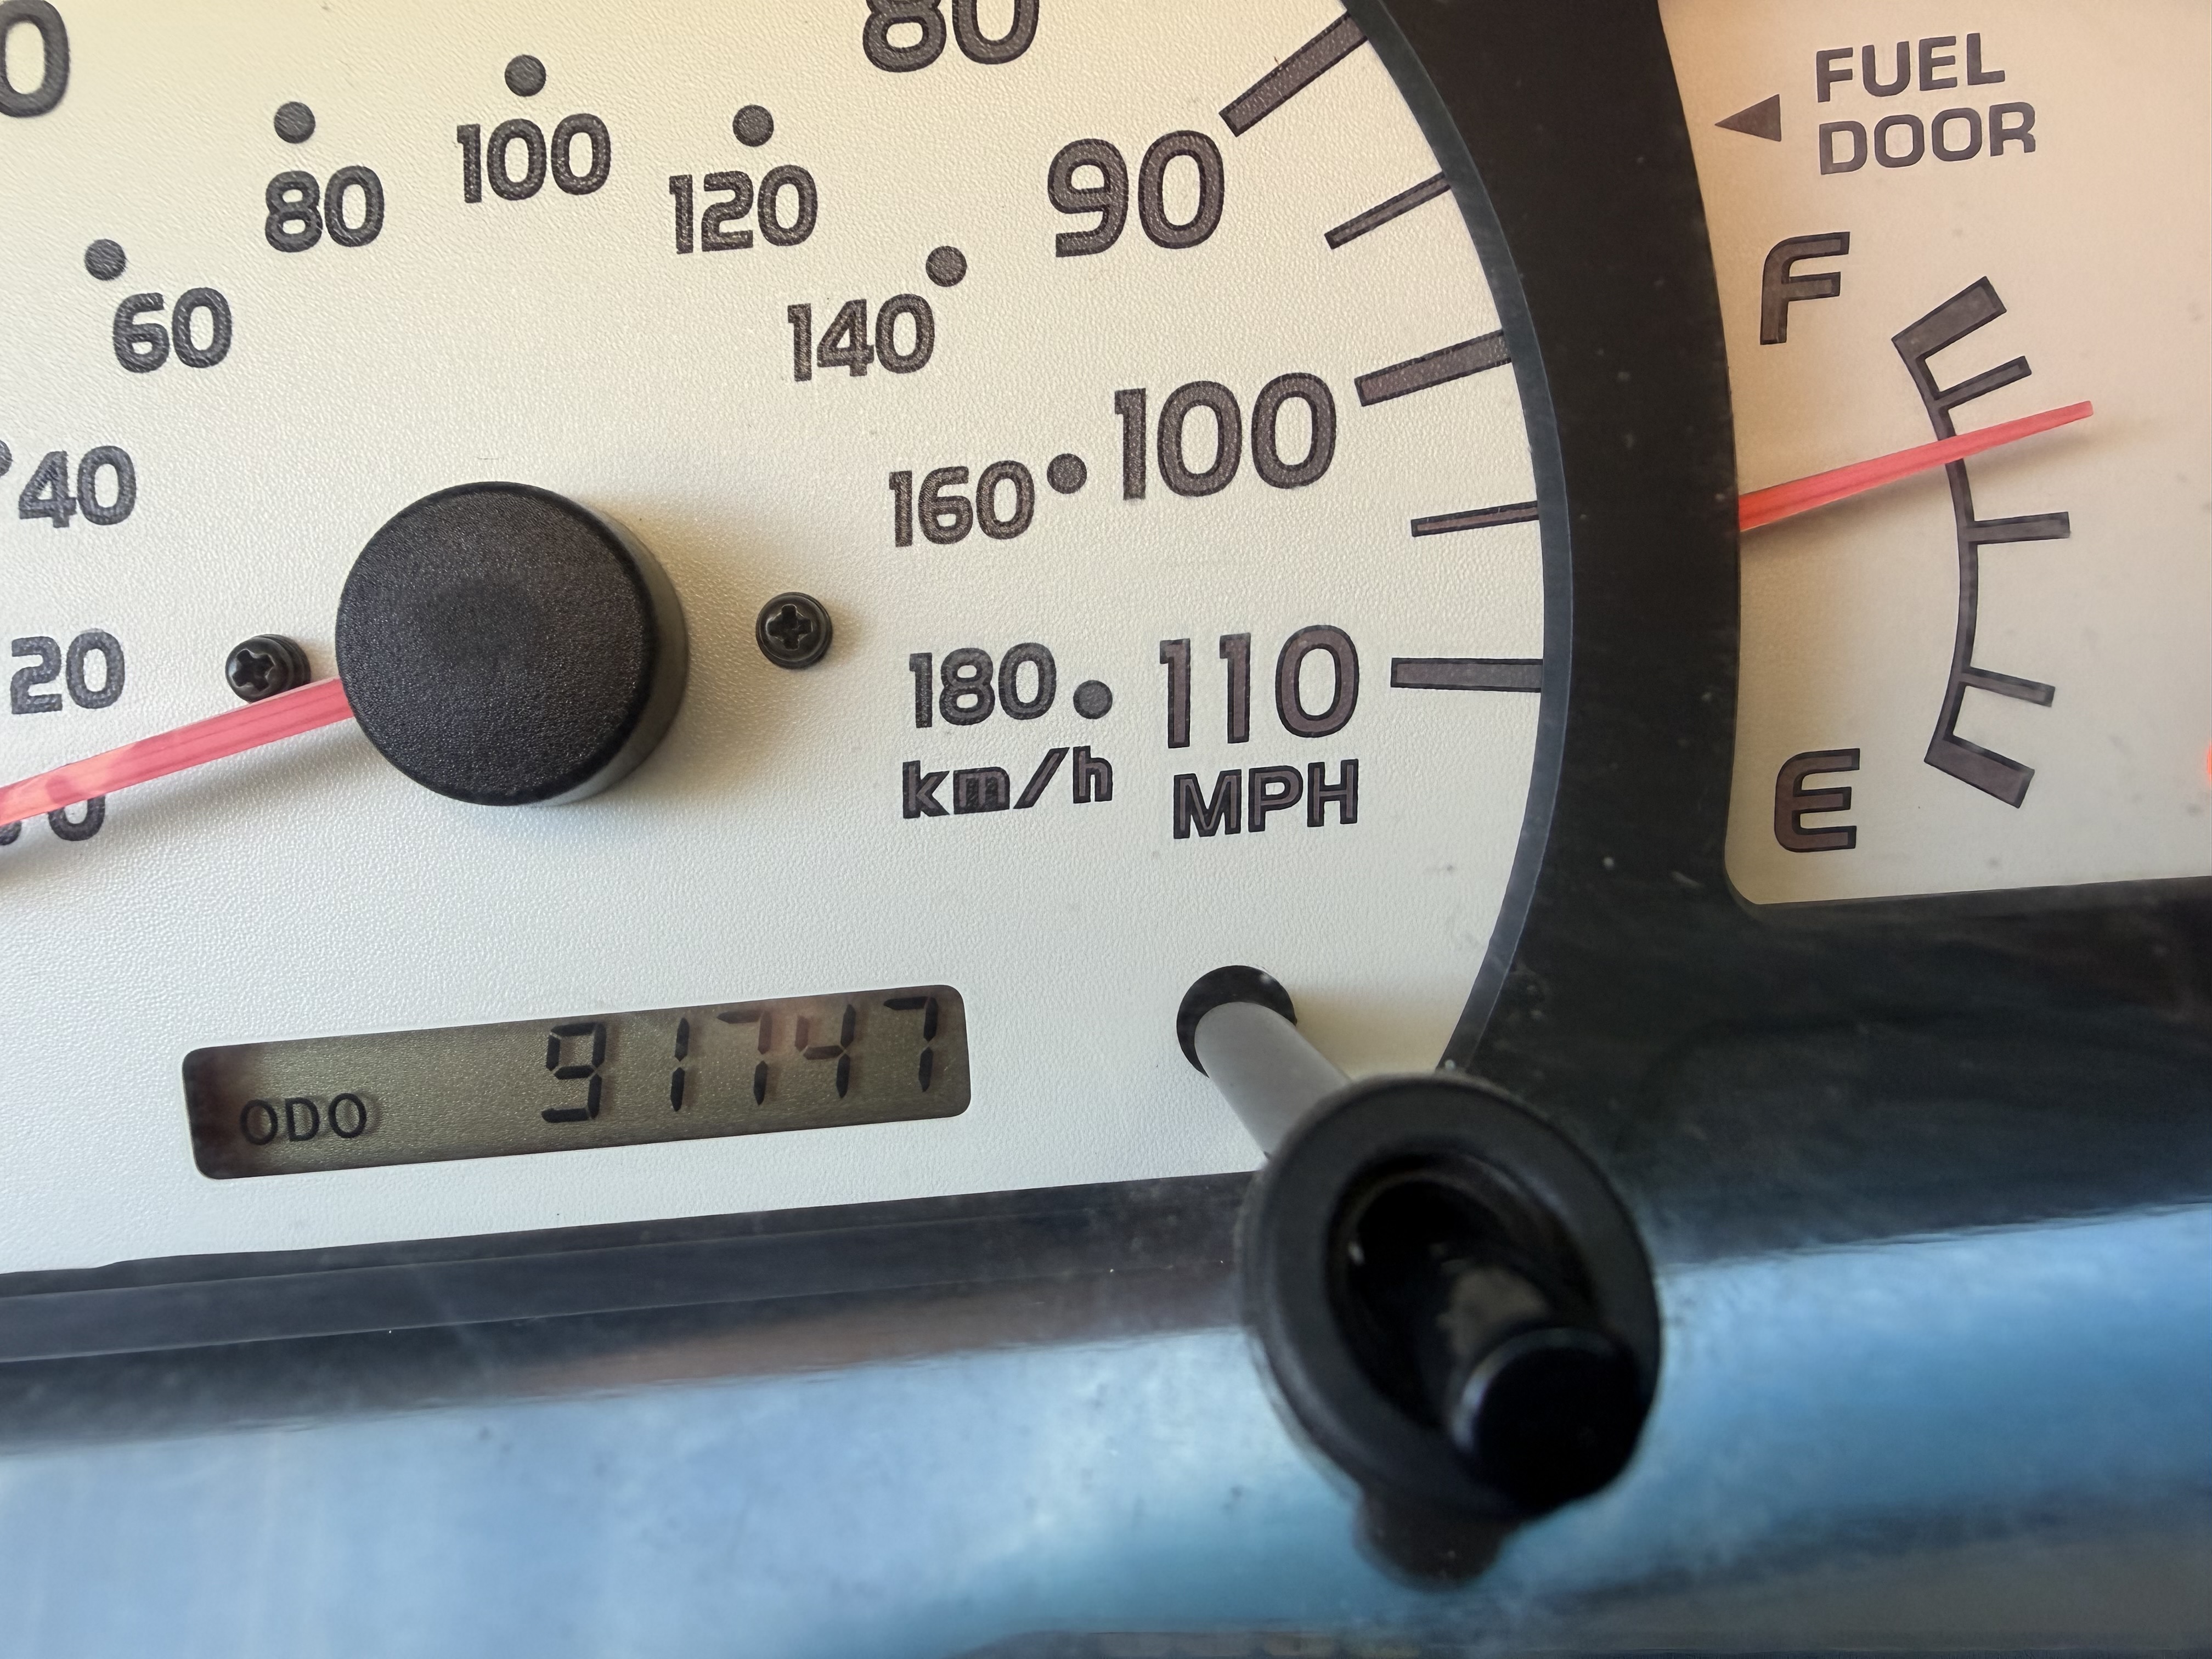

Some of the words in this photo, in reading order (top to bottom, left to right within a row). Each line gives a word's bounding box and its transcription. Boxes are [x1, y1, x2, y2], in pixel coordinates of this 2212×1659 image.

[863, 0, 1040, 73] 80
[1816, 33, 2006, 103] FUEL
[456, 114, 611, 204] 100
[1819, 101, 2036, 175] DOOR
[264, 165, 385, 252] 80
[669, 165, 818, 254] 120
[1048, 130, 1225, 257] 90
[112, 287, 233, 373] 60
[1759, 231, 1850, 345] F
[787, 294, 935, 382] 140
[1114, 372, 1336, 501] 100
[18, 445, 137, 528] 40
[889, 460, 1035, 548] 160
[10, 628, 126, 715] 20
[909, 642, 1057, 729] 180
[1160, 624, 1359, 749] 110
[902, 746, 1113, 819] km/h
[1173, 759, 1359, 839] MPH
[1774, 748, 1860, 853] E
[240, 1093, 367, 1146] ODO
[541, 995, 939, 1123] 91747
